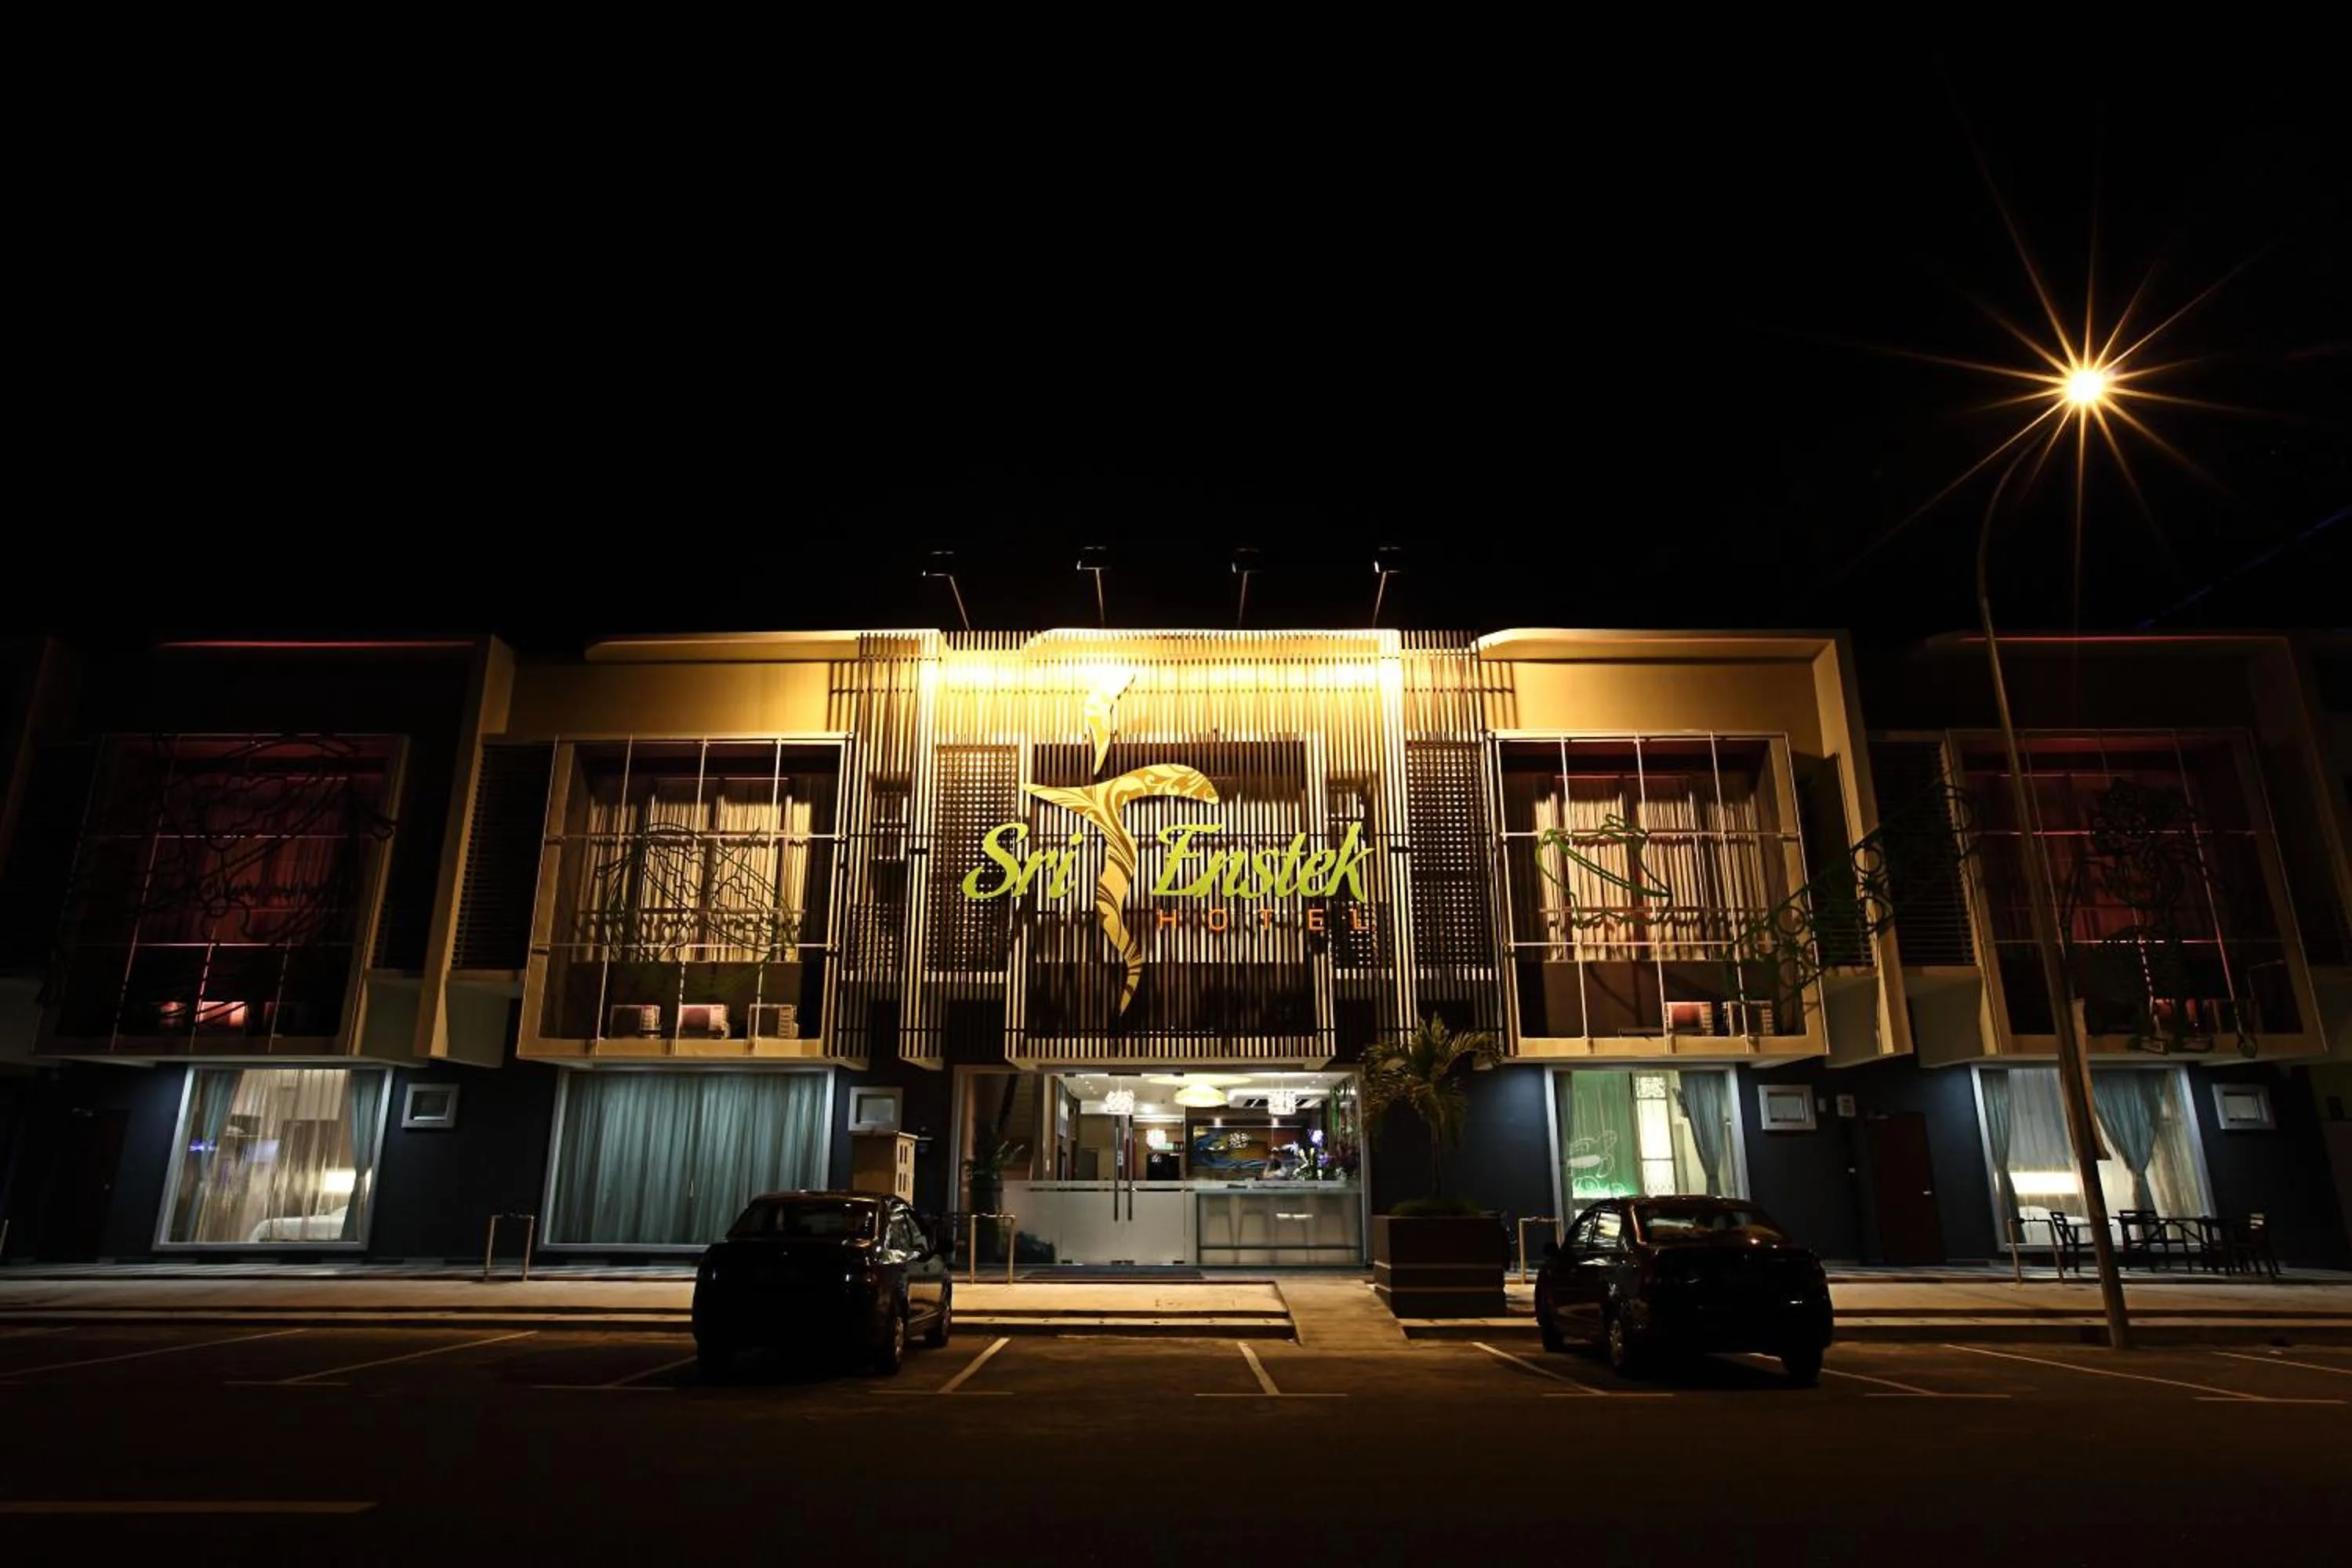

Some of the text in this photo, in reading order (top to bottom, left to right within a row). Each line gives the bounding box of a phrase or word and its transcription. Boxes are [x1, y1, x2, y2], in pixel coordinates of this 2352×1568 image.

[962, 821, 1374, 902] Sri Enstek
[1157, 909, 1371, 931] HOTEL
